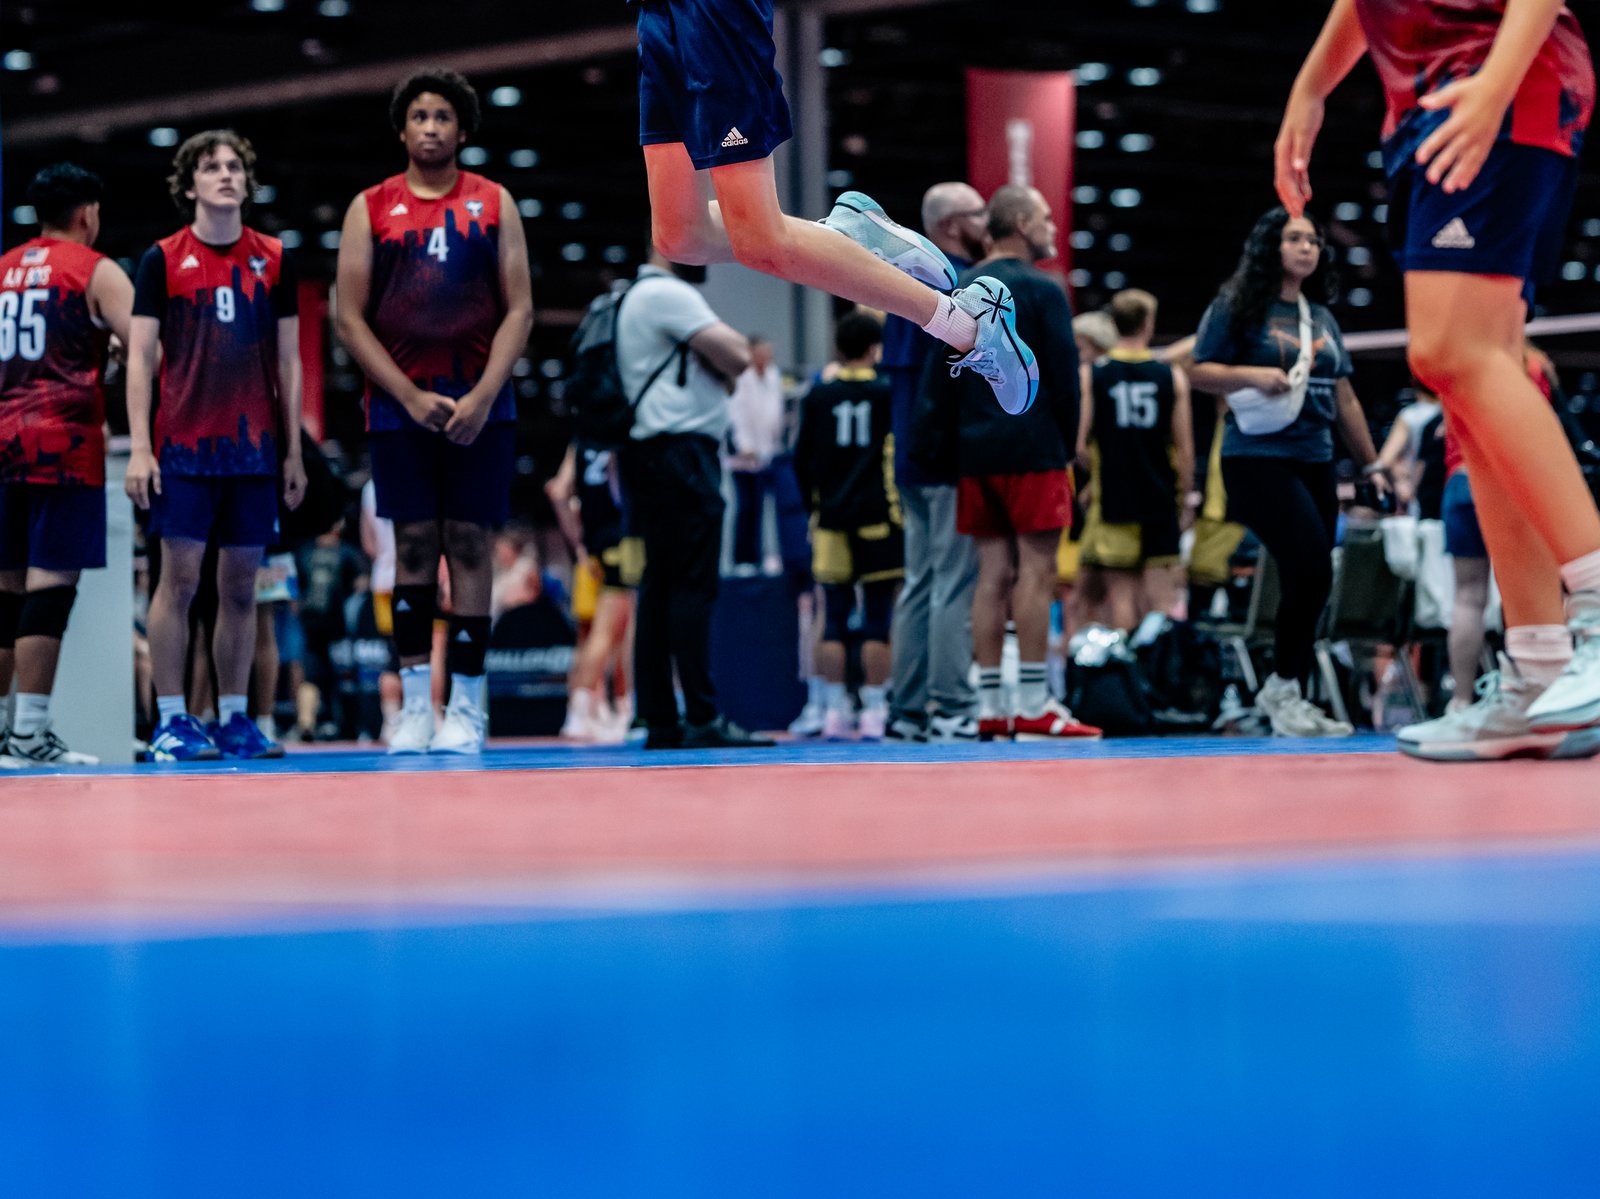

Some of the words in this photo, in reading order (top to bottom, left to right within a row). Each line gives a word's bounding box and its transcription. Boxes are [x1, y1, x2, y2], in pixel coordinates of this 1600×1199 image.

[721, 137, 749, 148] adidas
[427, 226, 449, 262] 4
[216, 285, 235, 323] 9
[1108, 380, 1158, 429] 15
[831, 400, 872, 448] 11
